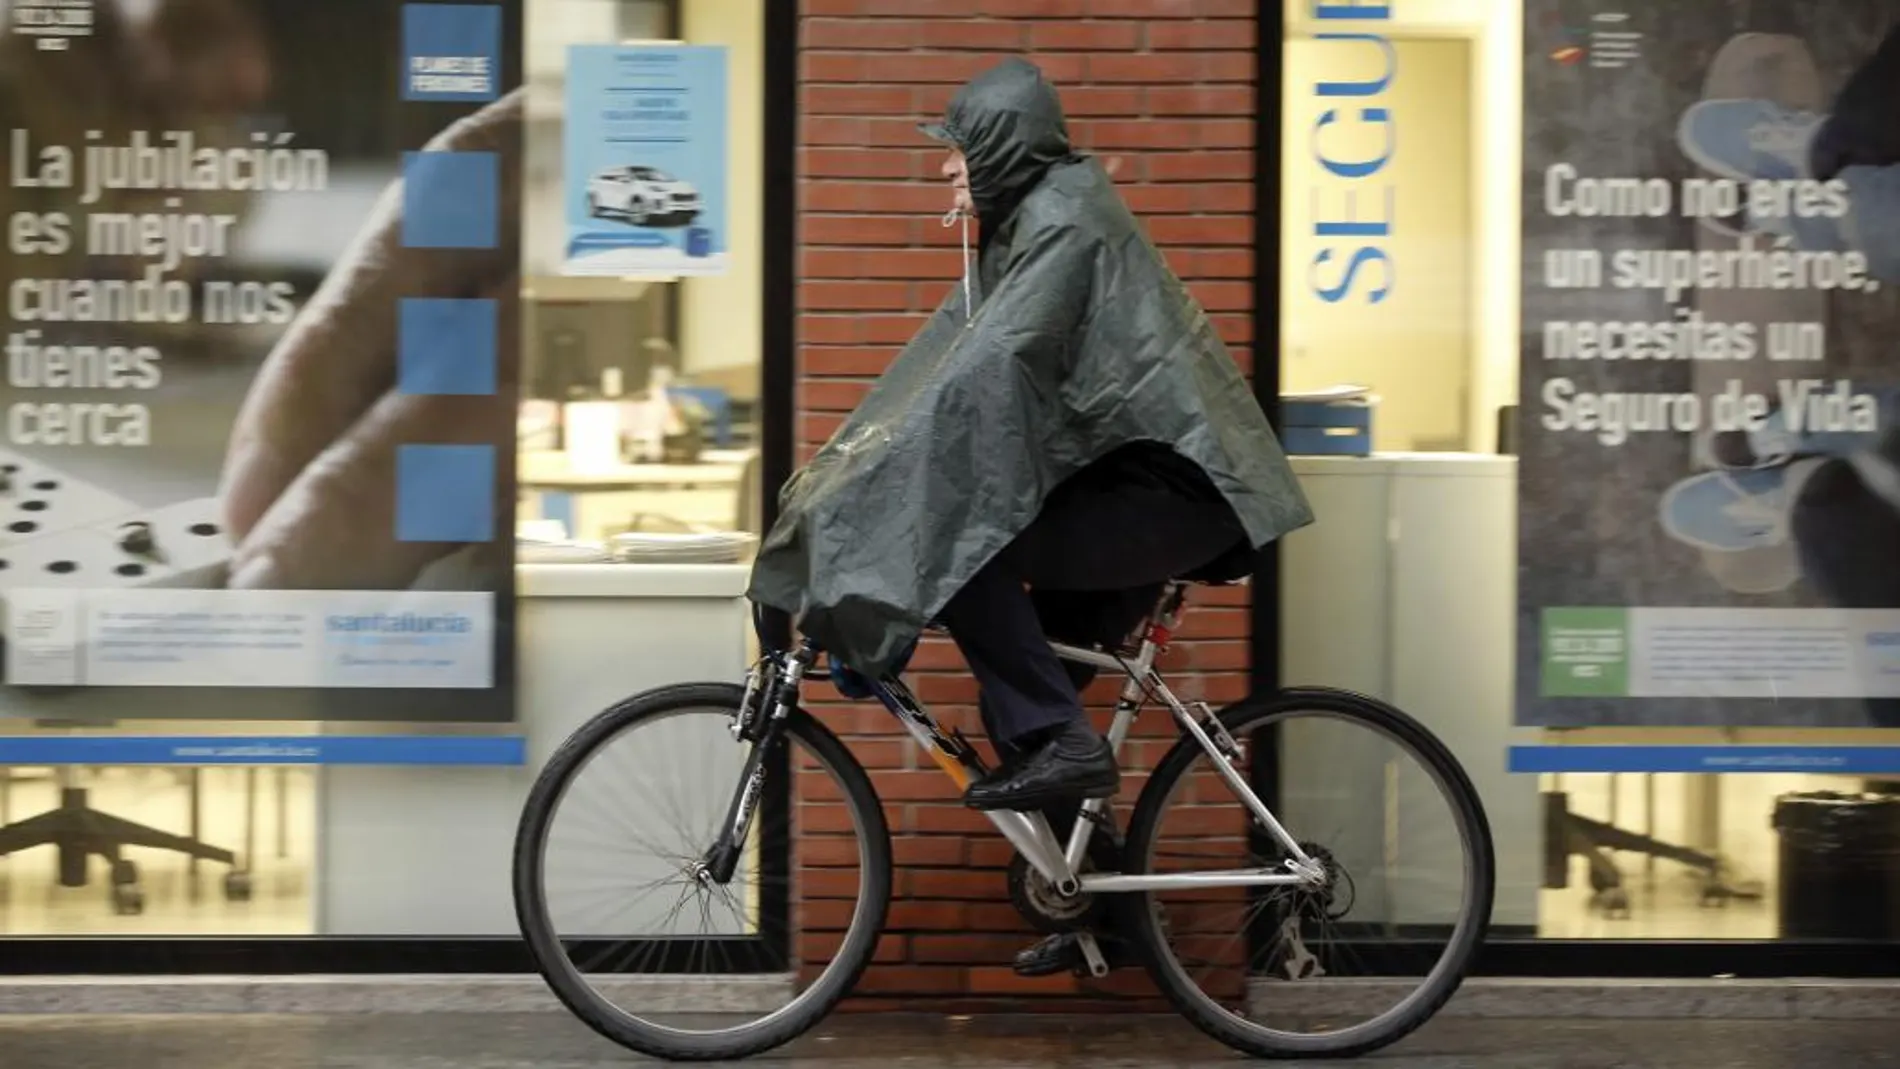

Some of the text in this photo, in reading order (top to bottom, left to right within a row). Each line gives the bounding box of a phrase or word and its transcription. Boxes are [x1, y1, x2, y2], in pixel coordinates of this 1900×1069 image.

[10, 129, 329, 204] La jubilación
[1310, 0, 1396, 304] SEGU
[1544, 162, 1849, 218] Como no eres
[8, 198, 236, 271] es mejor
[8, 265, 296, 324] cuando nos
[1544, 234, 1880, 302] un superhéroe,
[4, 329, 162, 389] tienes
[1542, 306, 1825, 360] necesitas un
[8, 400, 151, 446] cerca
[1541, 377, 1878, 446] Seguro de Vida
